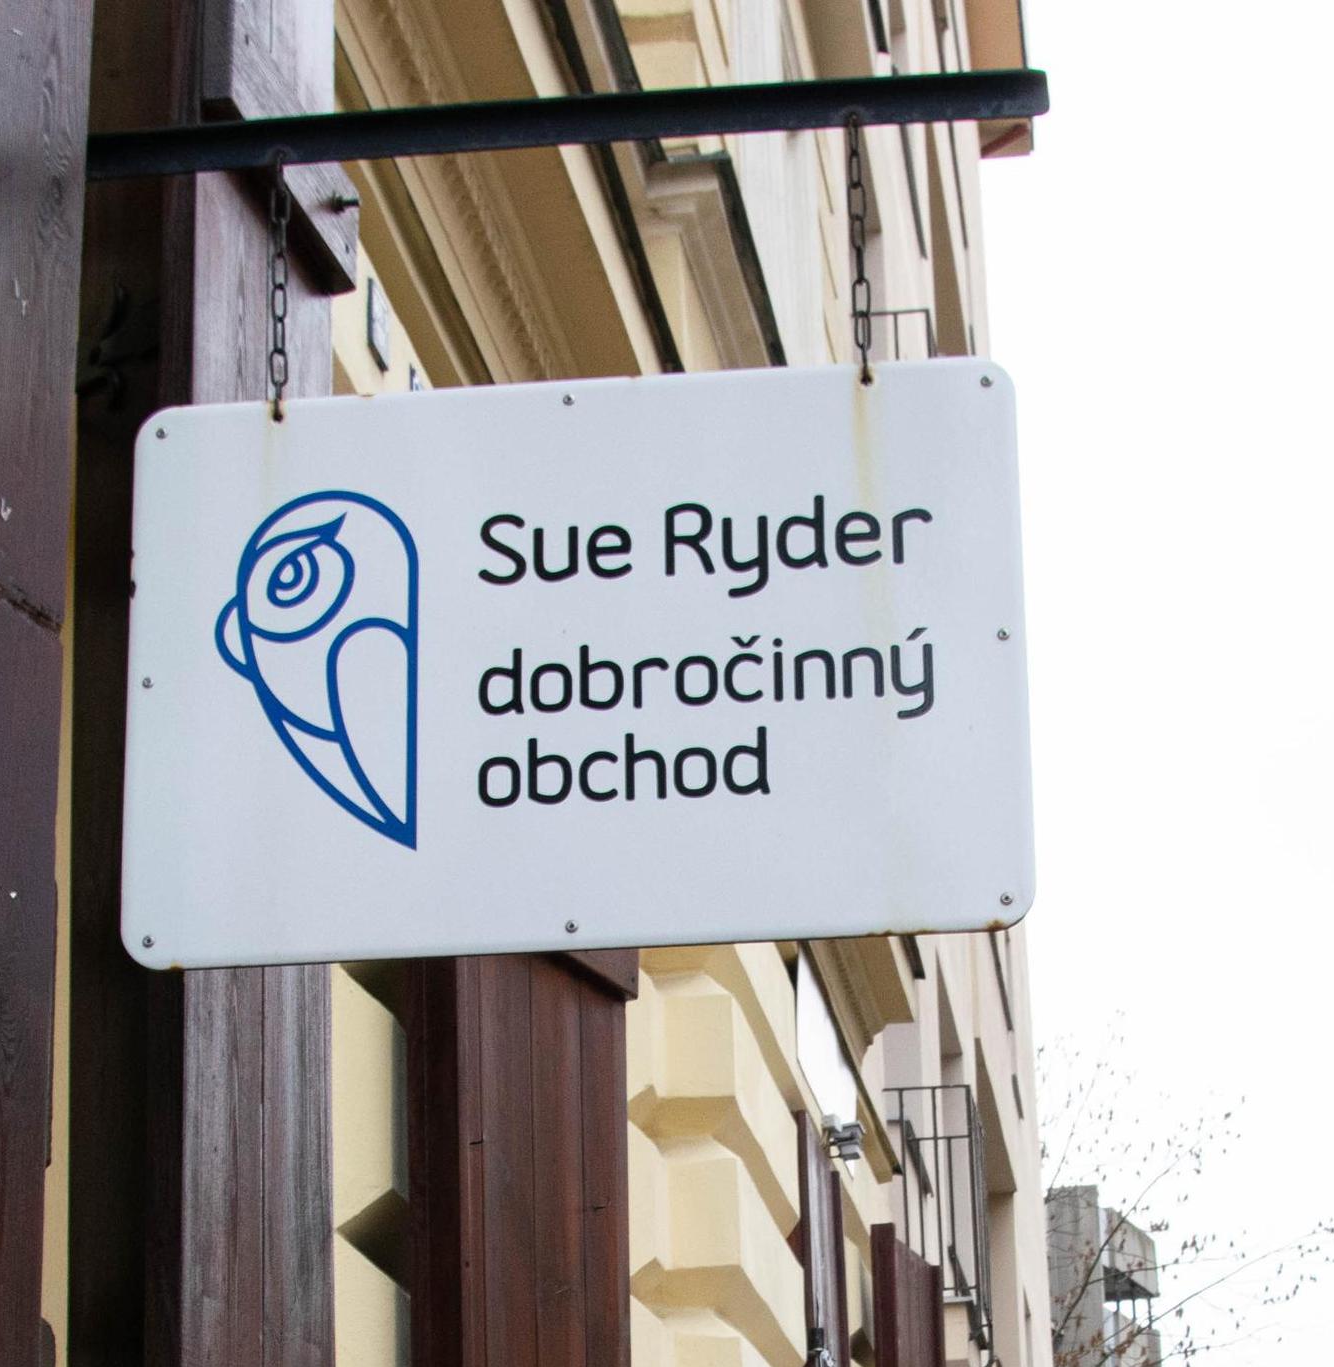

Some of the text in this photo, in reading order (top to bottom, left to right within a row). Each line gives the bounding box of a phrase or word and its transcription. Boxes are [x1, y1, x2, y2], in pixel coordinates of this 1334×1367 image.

[477, 493, 934, 599] Sue Ryder
[477, 625, 935, 720] dobročinný
[477, 725, 772, 809] obchod
